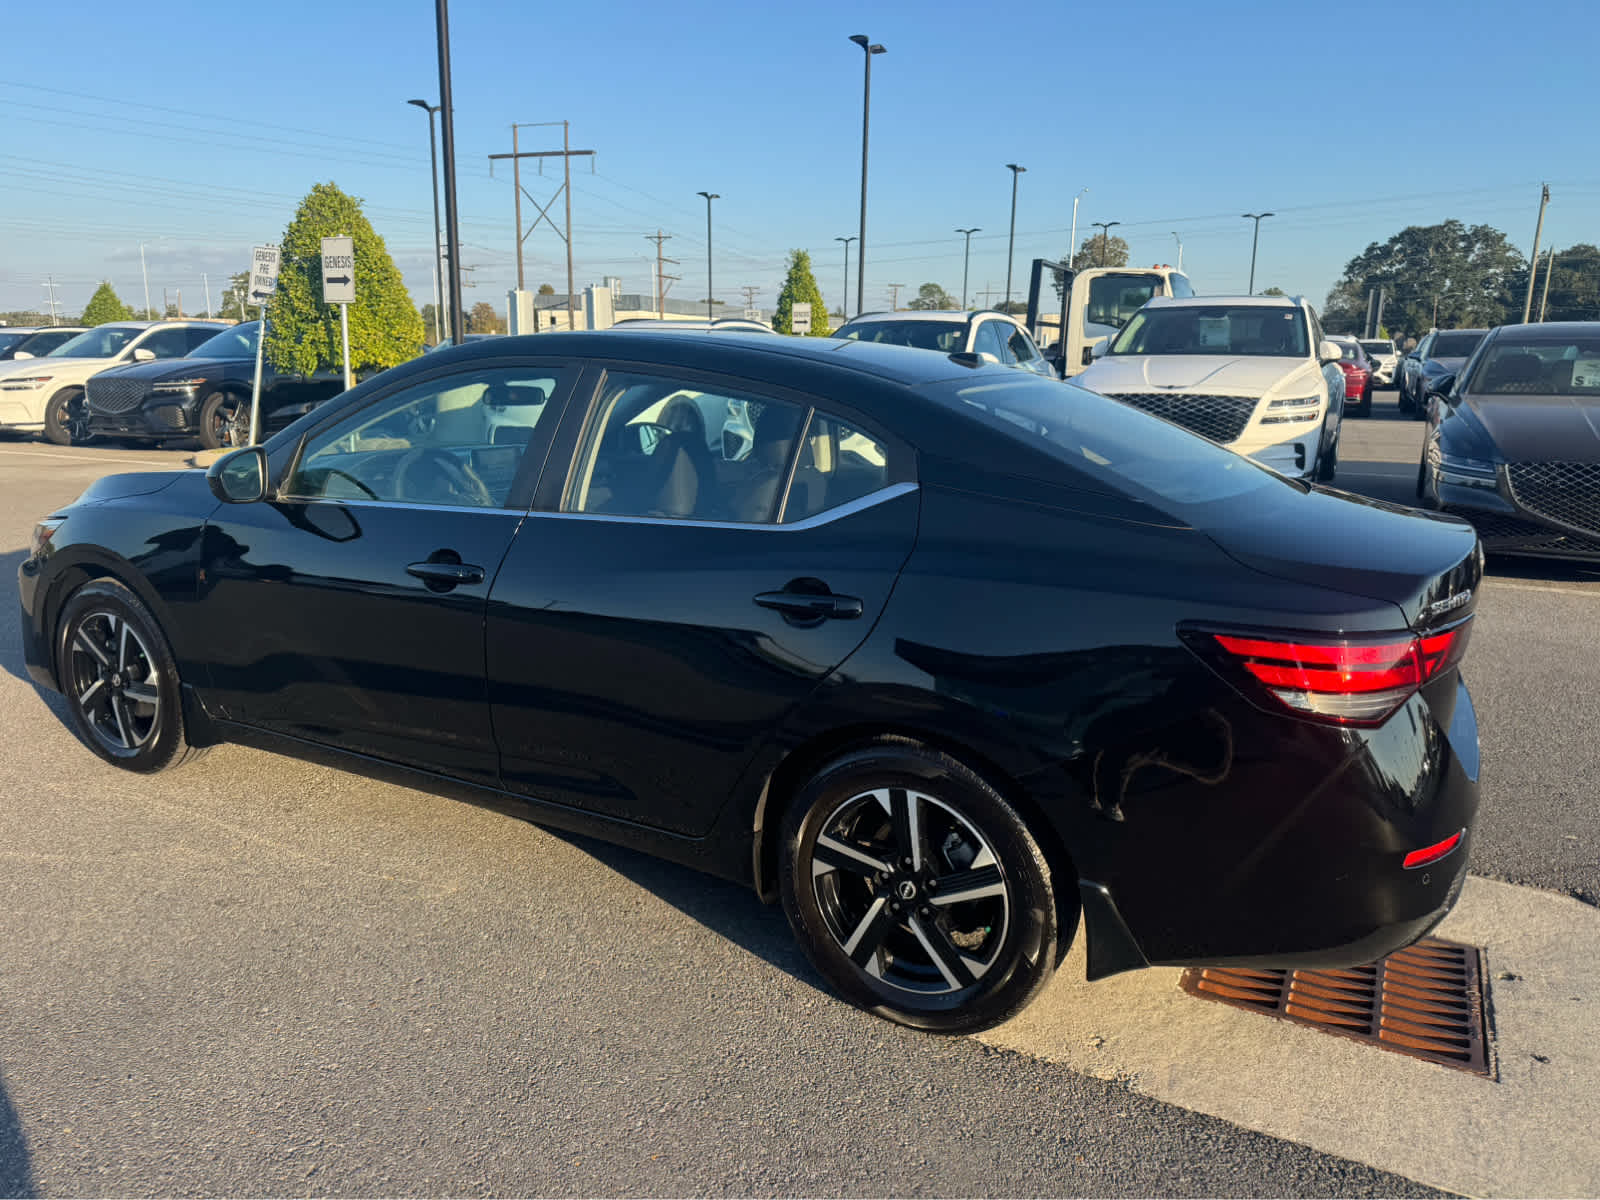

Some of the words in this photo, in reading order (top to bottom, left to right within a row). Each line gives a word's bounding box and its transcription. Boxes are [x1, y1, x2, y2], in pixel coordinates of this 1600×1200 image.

[255, 250, 276, 263] GENESIS
[324, 256, 352, 269] GENESIS
[259, 263, 270, 274] PRE
